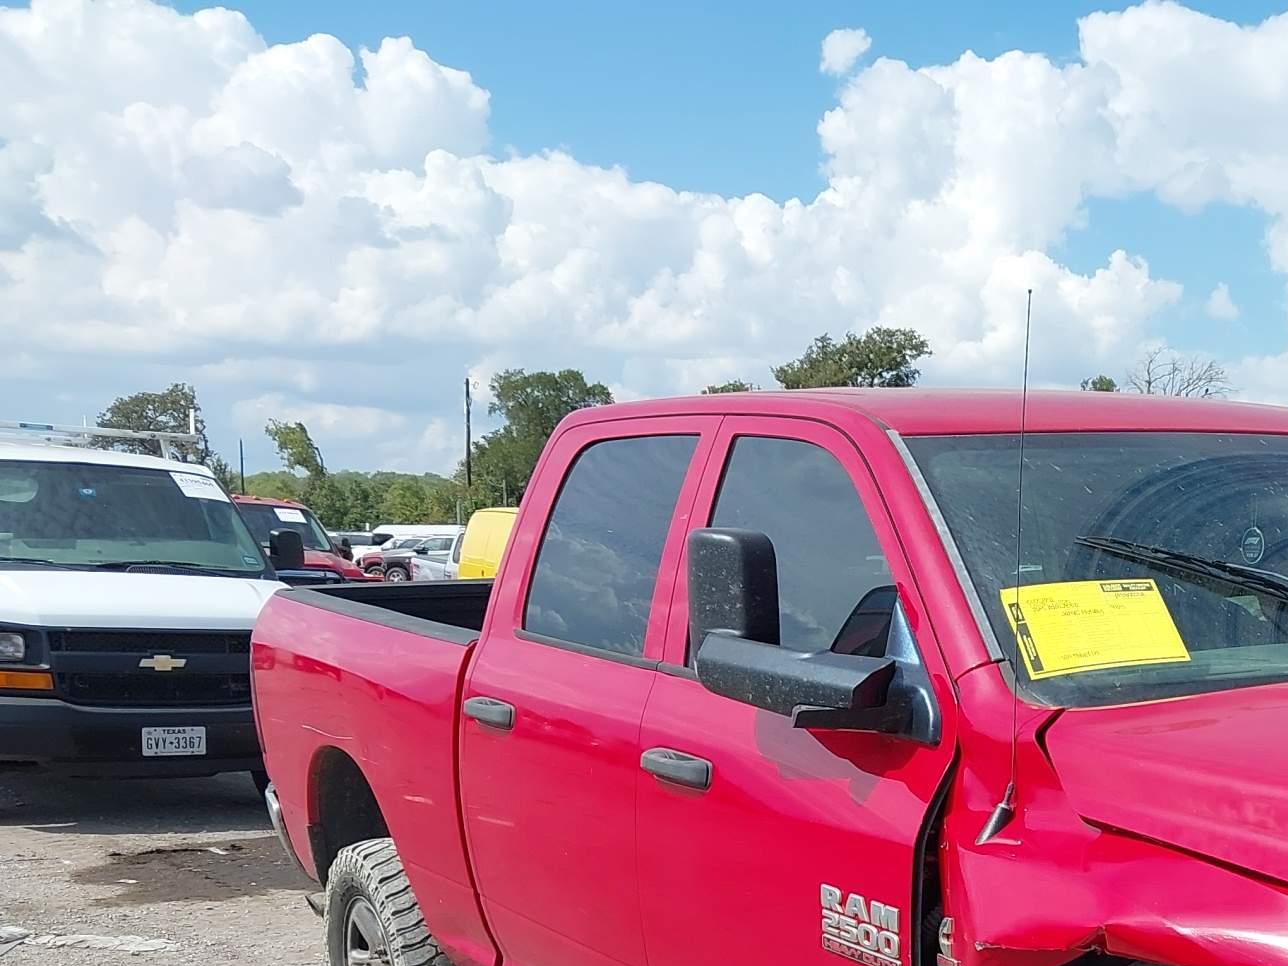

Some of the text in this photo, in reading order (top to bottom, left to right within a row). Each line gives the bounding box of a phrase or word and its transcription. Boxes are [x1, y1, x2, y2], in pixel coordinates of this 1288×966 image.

[820, 883, 900, 932] RAM
[822, 908, 900, 958] 2500
[824, 937, 862, 958] HEAVY
